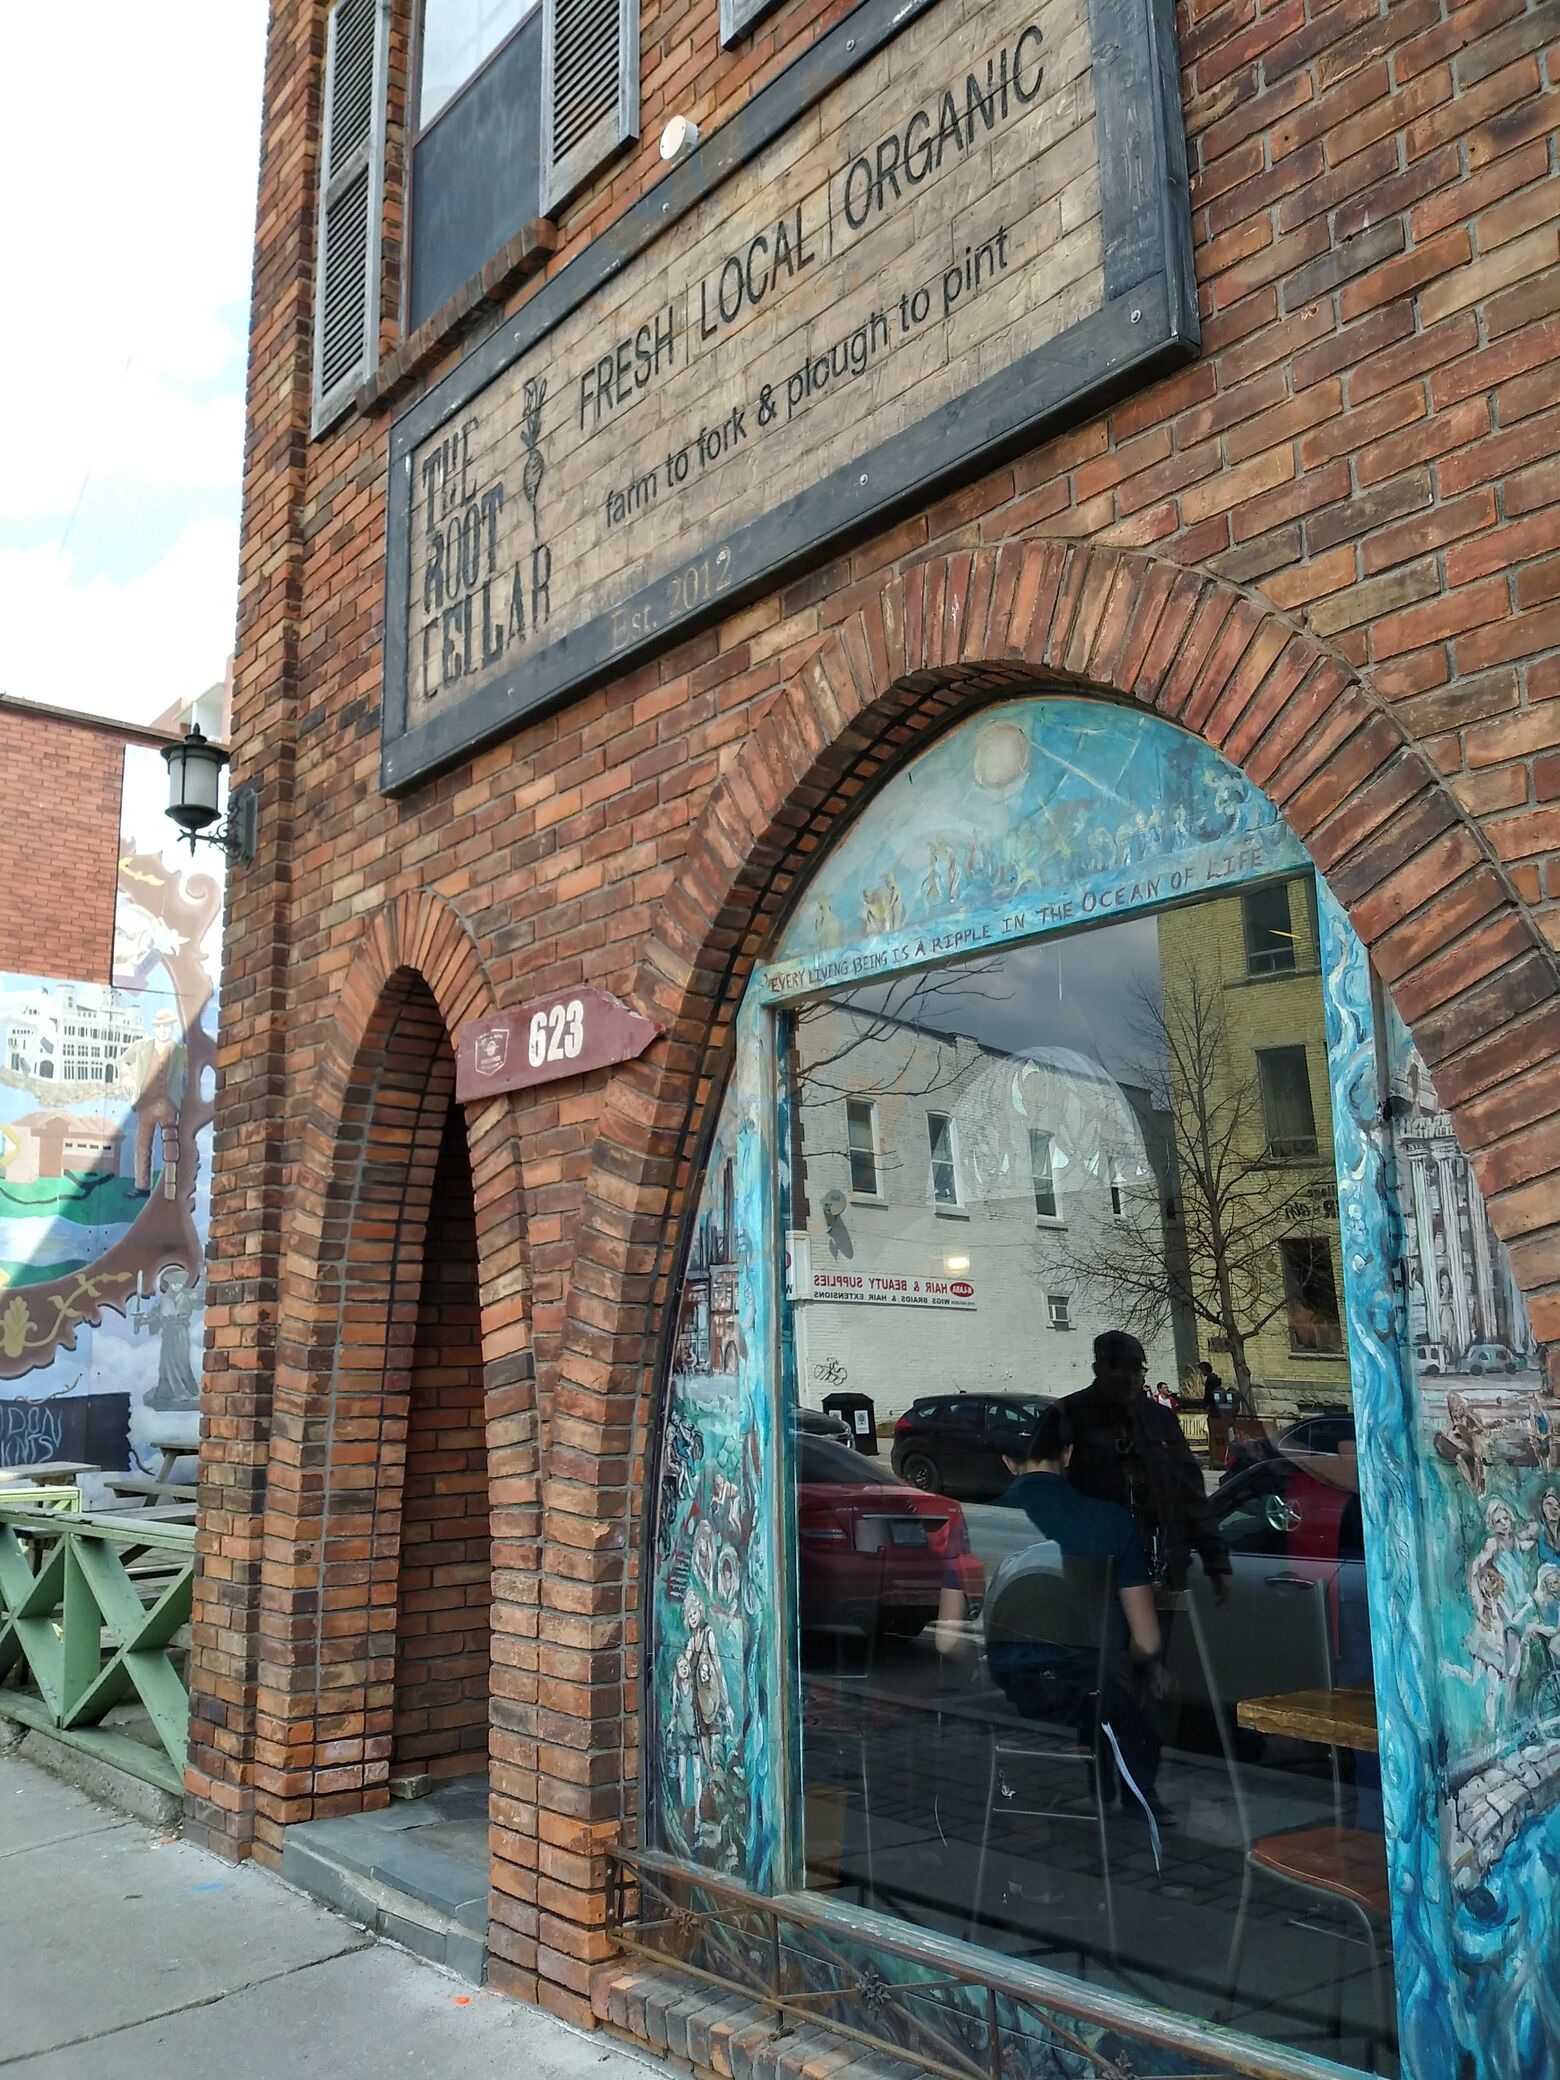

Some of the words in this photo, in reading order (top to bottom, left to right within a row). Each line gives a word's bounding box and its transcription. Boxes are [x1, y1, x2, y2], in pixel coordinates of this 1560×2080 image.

[578, 305, 674, 431] FRESH
[701, 205, 815, 341] LOCAL
[844, 25, 1044, 231] ORGANIC
[606, 473, 657, 527] farm
[666, 451, 689, 488] to
[697, 407, 747, 467] fork
[757, 384, 776, 427] &
[786, 310, 889, 419] plough
[900, 287, 930, 332] to
[942, 224, 1007, 317] pint
[422, 415, 479, 535] THE
[423, 481, 504, 615] ROOT
[611, 604, 657, 652] Est.
[667, 545, 732, 619] 2012
[422, 544, 551, 701] CELLAR
[770, 970, 805, 992] EVERY
[808, 960, 848, 982] LIVING
[852, 950, 888, 974] BEING
[892, 946, 909, 963] IS
[914, 938, 926, 957] A
[932, 924, 992, 952] RIPPLE
[1001, 913, 1025, 934] IN
[1036, 901, 1074, 925] THE
[1081, 876, 1161, 913] OCEAN
[1170, 867, 1194, 890] OF
[1207, 848, 1263, 881] LIFE
[528, 1000, 584, 1068] 623
